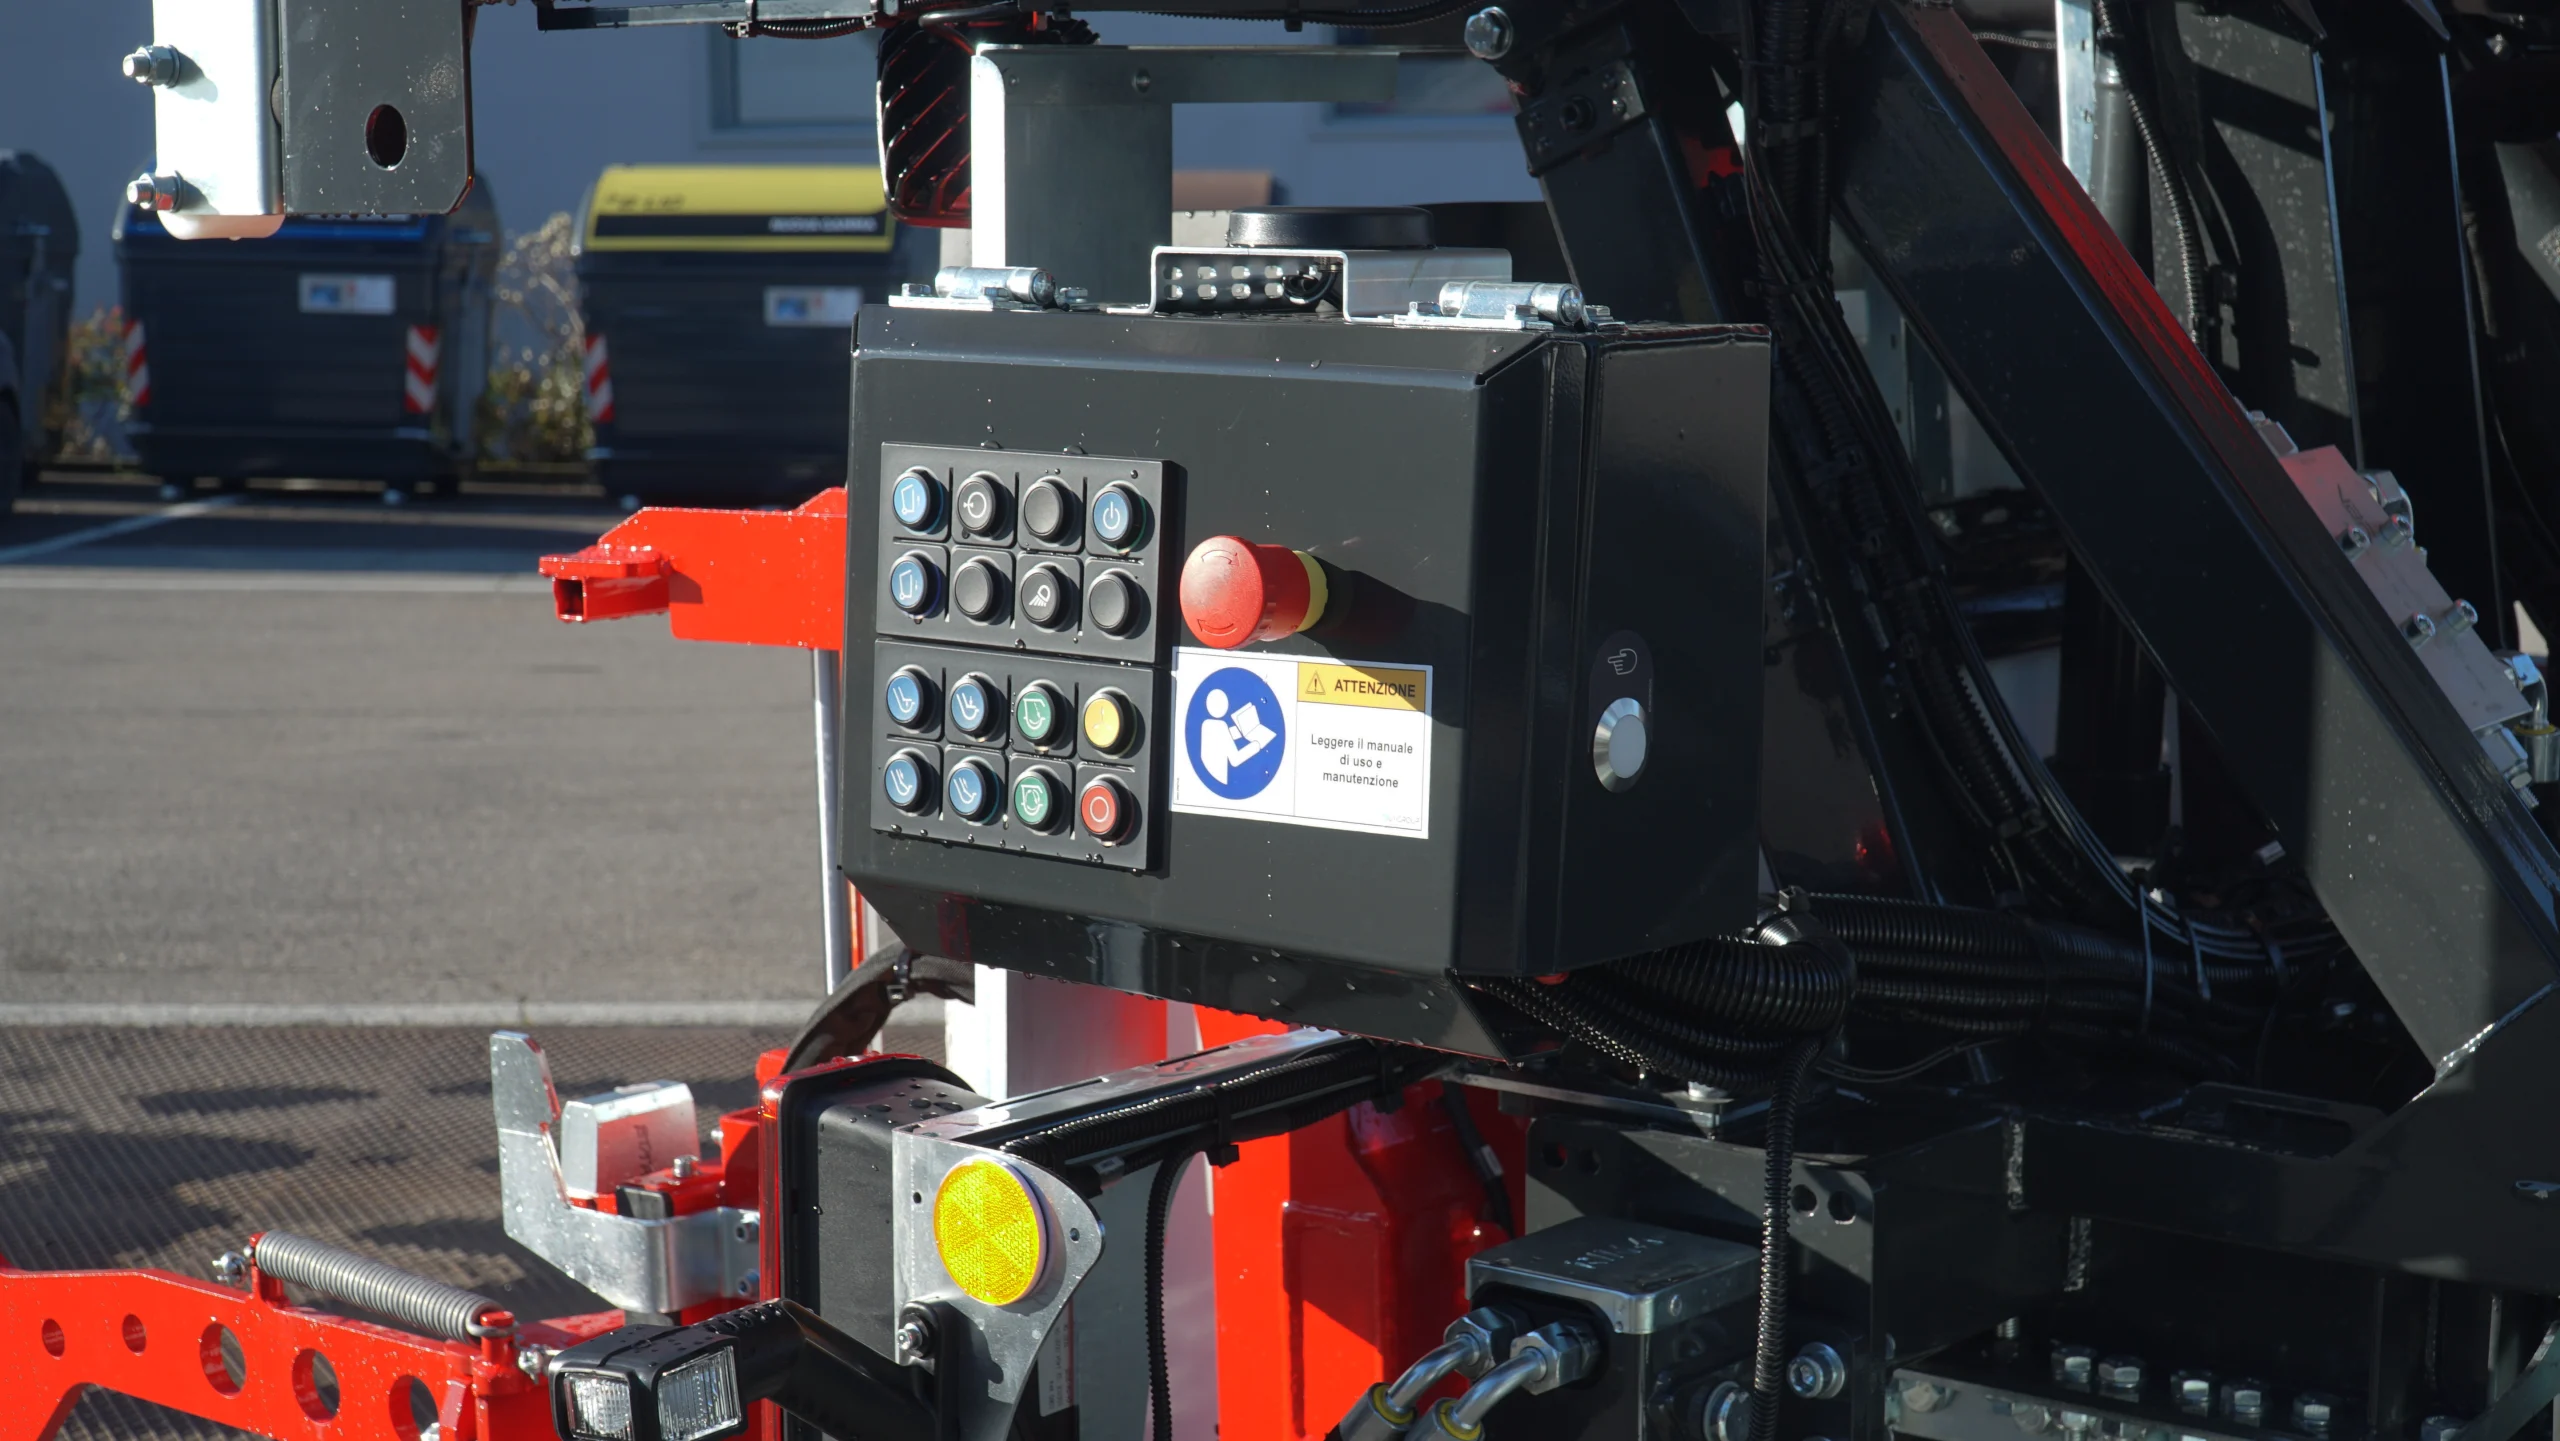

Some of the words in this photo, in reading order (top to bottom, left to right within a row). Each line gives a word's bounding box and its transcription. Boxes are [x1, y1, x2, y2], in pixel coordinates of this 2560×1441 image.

[1334, 679, 1416, 698] ATTENZIONE
[1311, 733, 1354, 750] Leggere
[1357, 737, 1364, 750] il
[1367, 741, 1413, 754] manuale
[1339, 754, 1350, 766] di
[1353, 757, 1373, 768] uso
[1376, 759, 1383, 769] e
[1323, 771, 1399, 788] manutenzione
